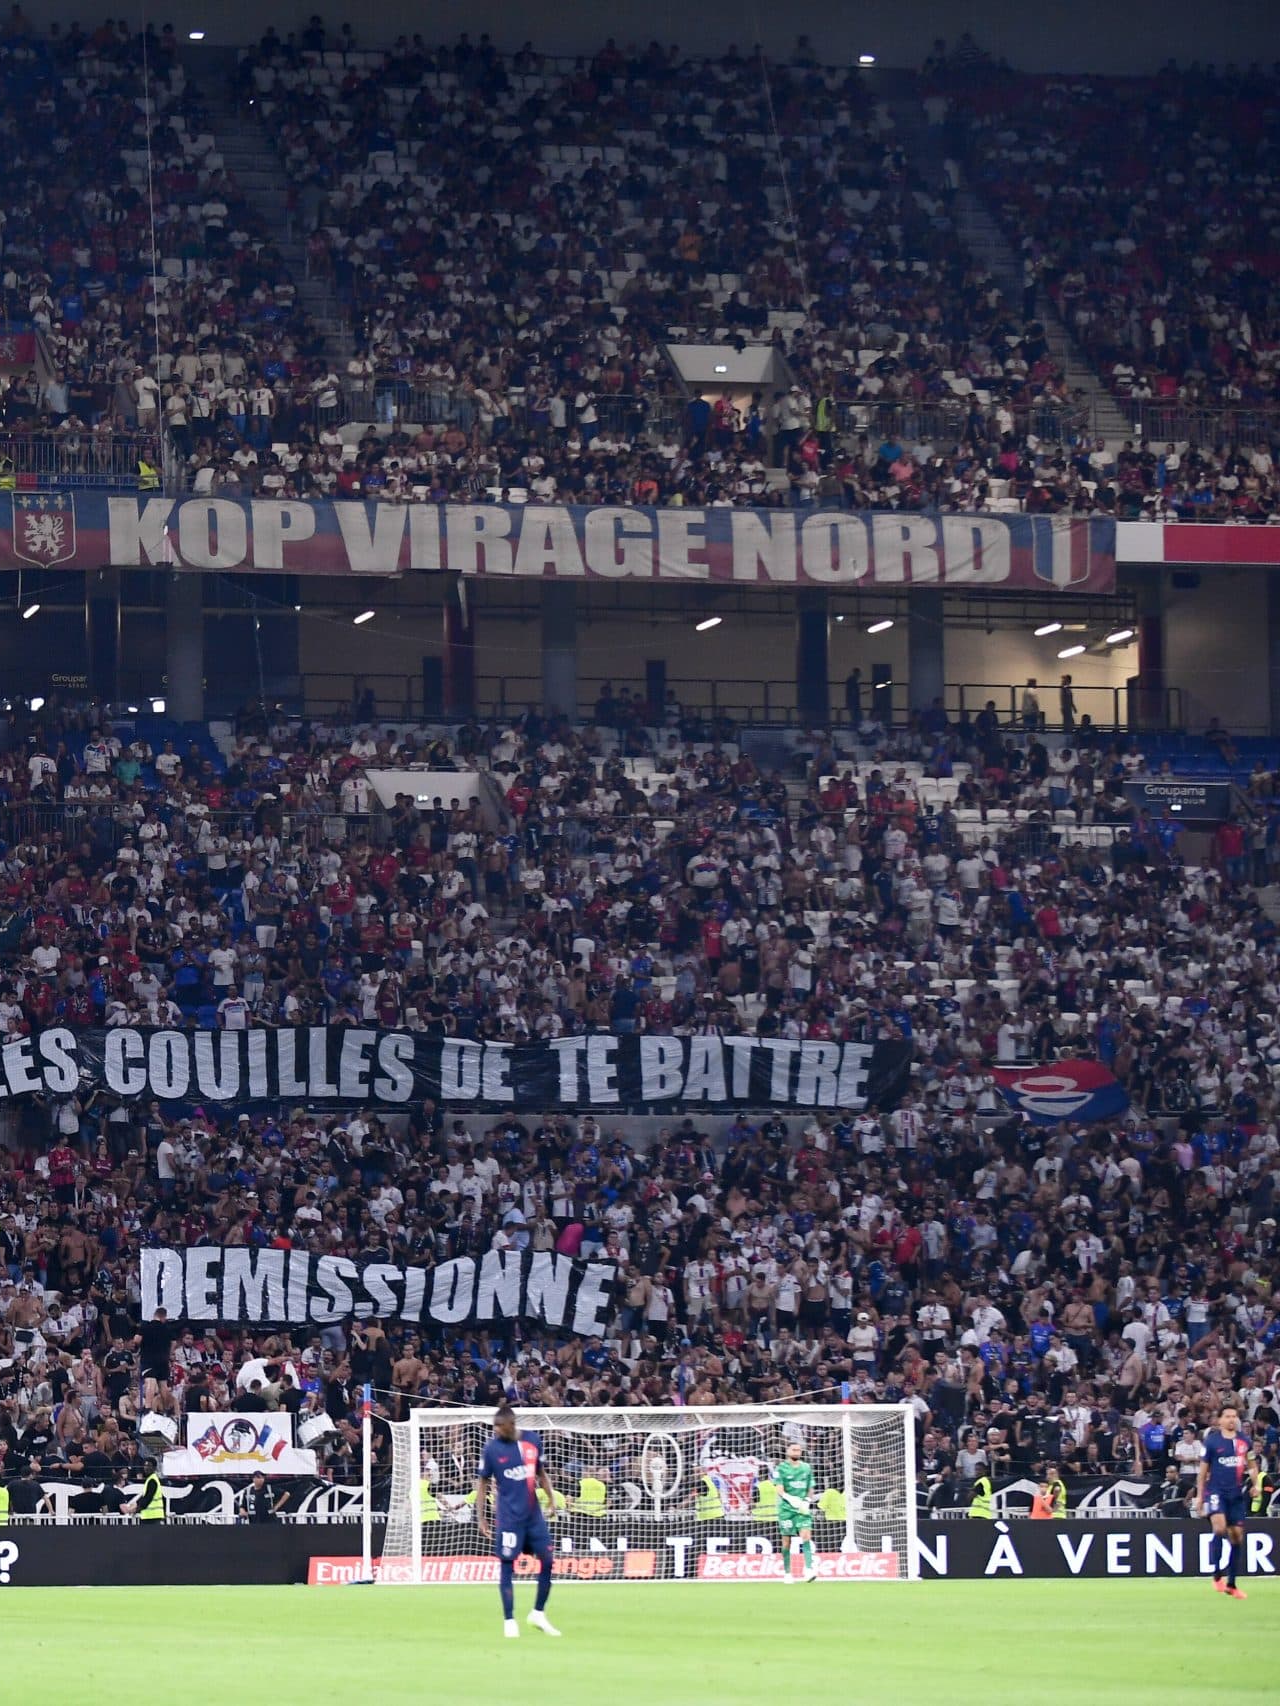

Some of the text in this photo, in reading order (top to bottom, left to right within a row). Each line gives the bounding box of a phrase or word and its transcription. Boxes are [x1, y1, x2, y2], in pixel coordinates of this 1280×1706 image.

[108, 497, 315, 568] KOP
[333, 501, 709, 578] VIRAGE
[731, 511, 1011, 583] NORD
[52, 674, 87, 685] Groupa
[1144, 784, 1207, 797] Groupama
[1167, 797, 1207, 805] STADIUM
[104, 1027, 415, 1102] COUILLES
[441, 1037, 515, 1102] DE
[549, 1035, 620, 1103] TE
[639, 1035, 874, 1110] BATTRE
[139, 1246, 615, 1336] DEMISSIONNE
[502, 1532, 517, 1547] 10
[984, 1520, 1023, 1575] À
[451, 1561, 501, 1582] BETTER
